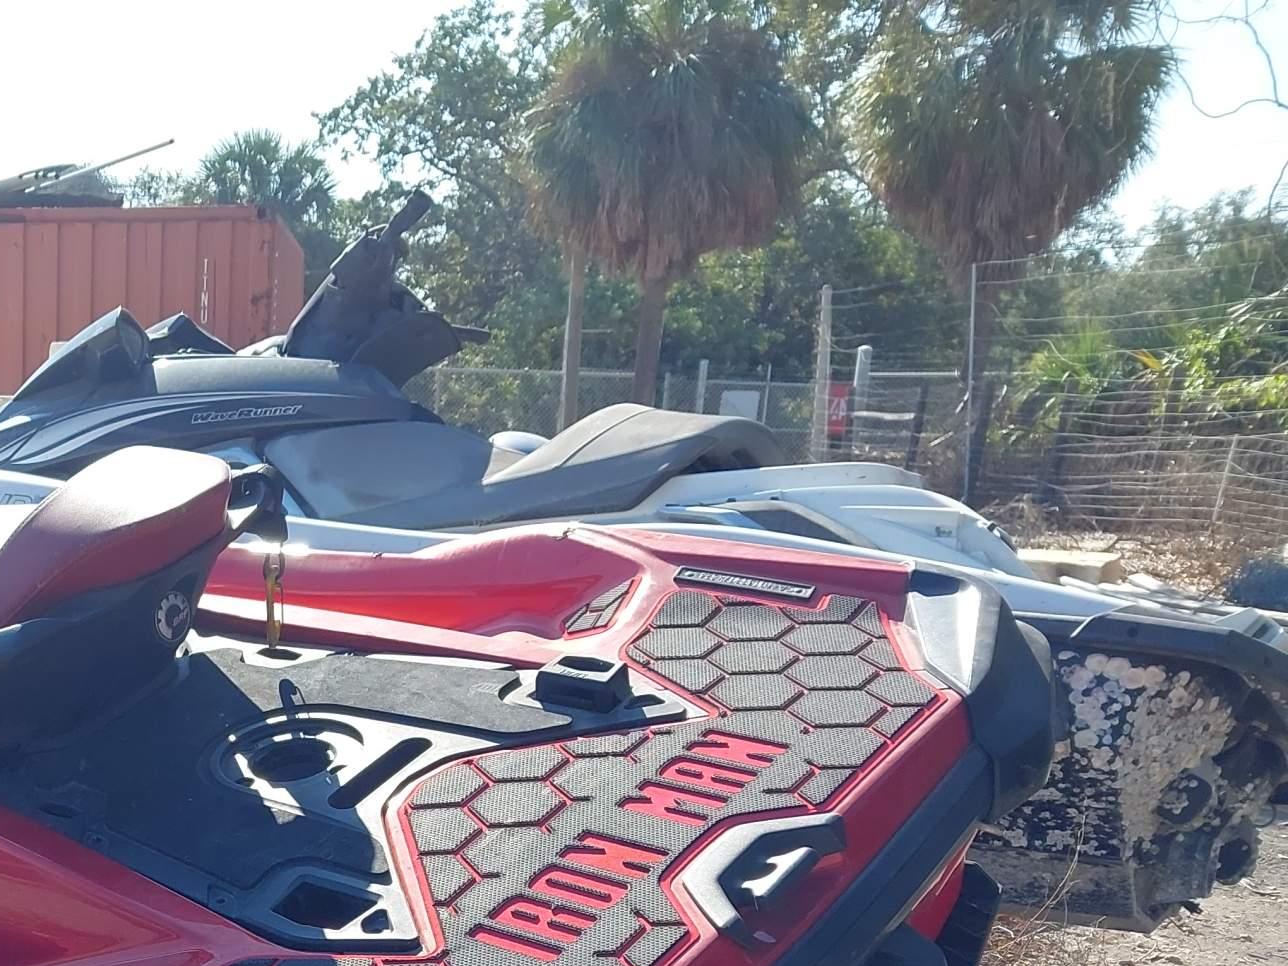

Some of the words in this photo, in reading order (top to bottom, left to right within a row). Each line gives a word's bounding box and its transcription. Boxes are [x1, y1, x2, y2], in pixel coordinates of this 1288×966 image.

[191, 403, 304, 425] WaveRunner
[465, 829, 670, 963] IRON
[615, 729, 790, 828] MAN
